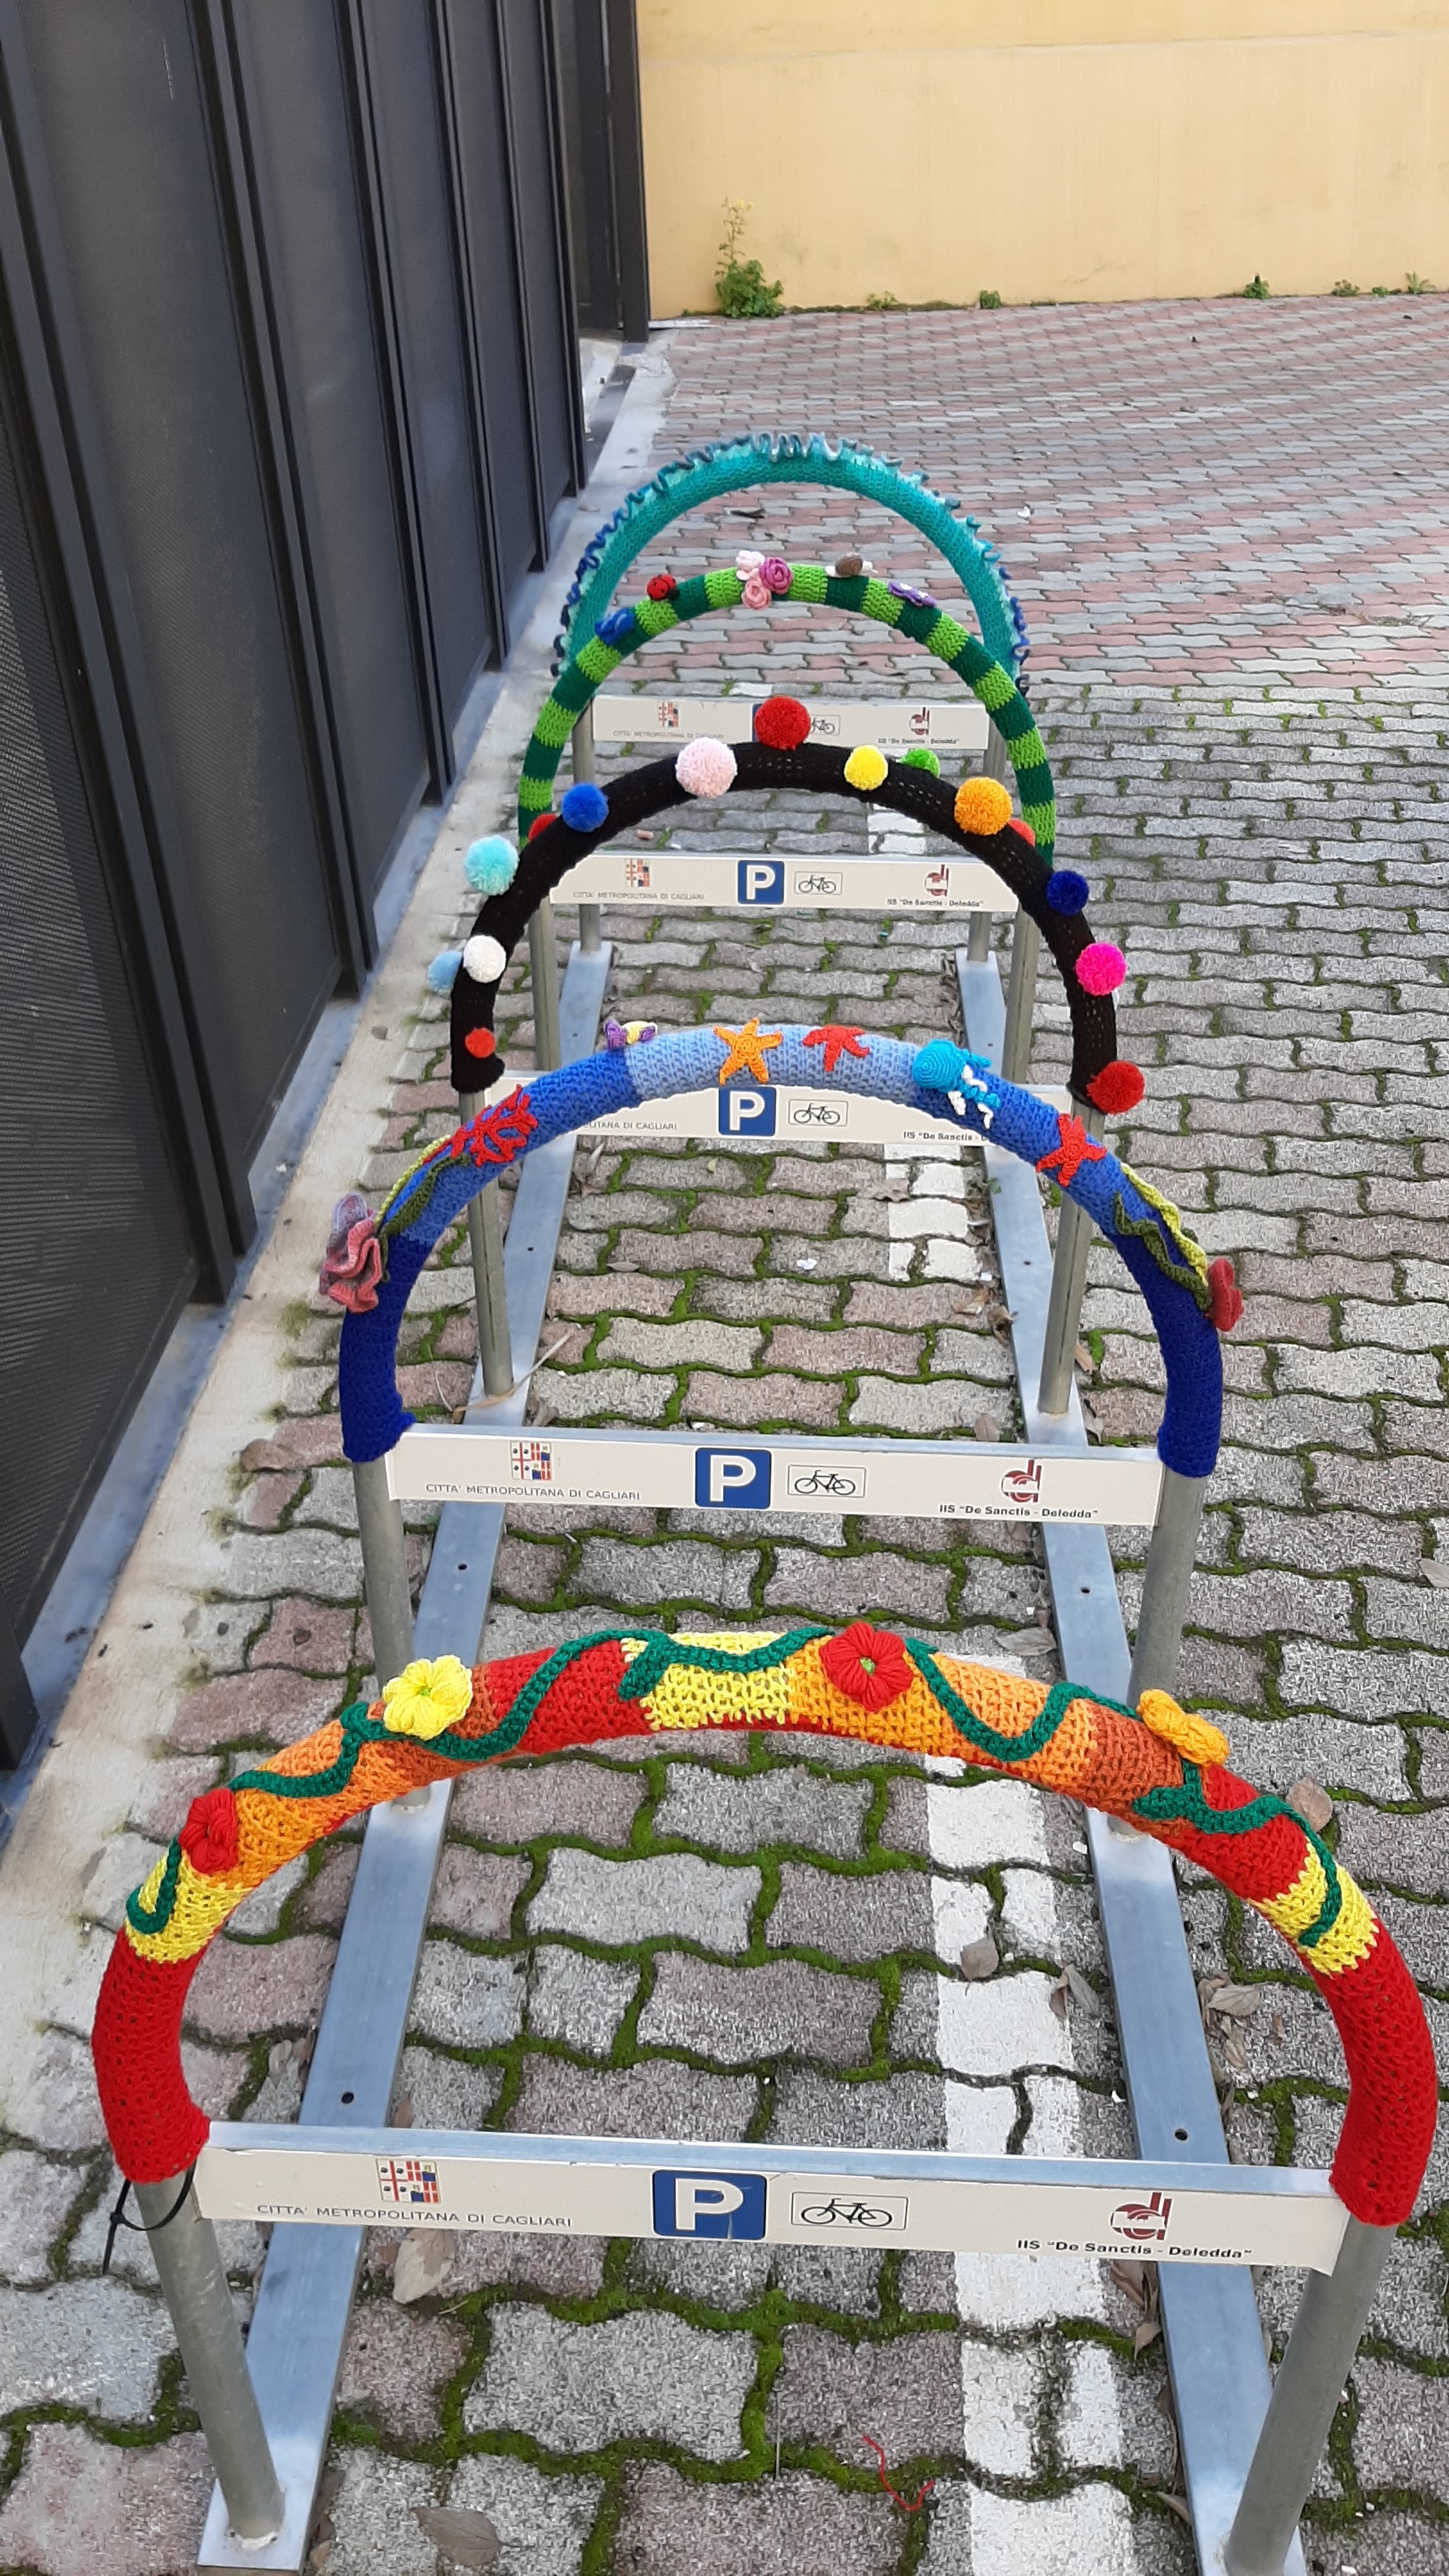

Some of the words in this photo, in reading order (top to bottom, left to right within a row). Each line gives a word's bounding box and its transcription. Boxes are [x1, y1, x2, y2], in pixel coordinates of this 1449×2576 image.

[747, 864, 776, 900] P
[730, 1091, 765, 1131] P
[636, 1122, 677, 1130] CAGLIARI
[710, 1454, 756, 1502] P
[466, 1485, 565, 1497] METROPOLITANA
[569, 1489, 581, 1498] DI
[586, 1490, 640, 1500] CAGLIARI
[939, 1504, 955, 1513] IIS
[985, 1506, 1031, 1516] Sanctis
[675, 2178, 744, 2230] P
[317, 2207, 460, 2222] METROPOLITANA
[467, 2213, 484, 2224] DI
[492, 2214, 571, 2227] CAGLIARI
[1017, 2239, 1041, 2250] IIS
[1084, 2242, 1152, 2255] Sanctis
